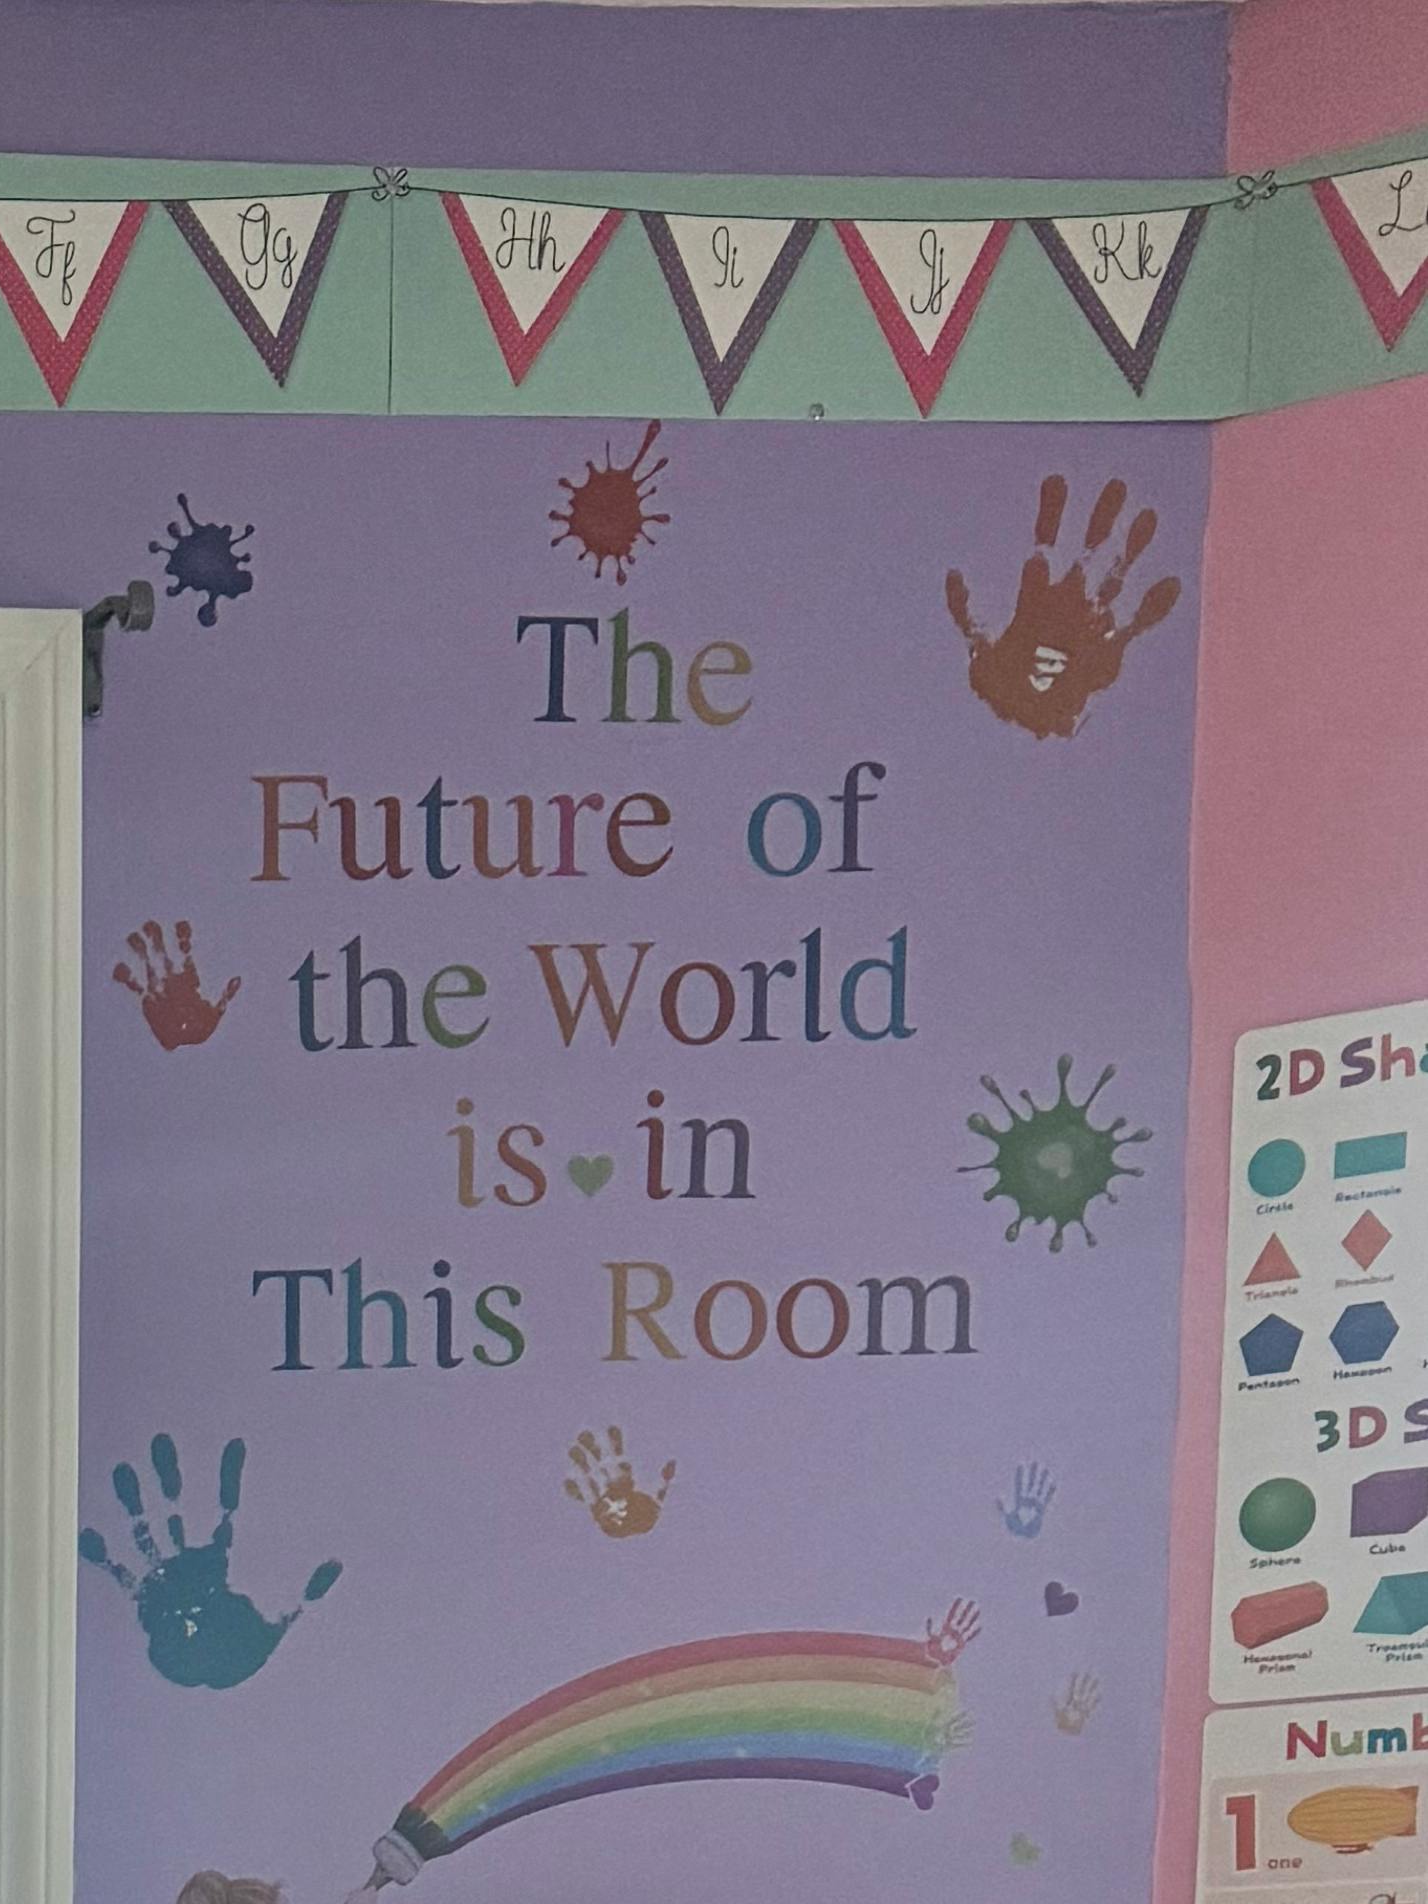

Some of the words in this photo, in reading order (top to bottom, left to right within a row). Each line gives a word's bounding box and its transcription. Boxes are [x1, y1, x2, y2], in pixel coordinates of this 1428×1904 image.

[1378, 170, 1428, 236] L
[27, 210, 79, 306] Ff
[237, 202, 298, 291] Gg
[496, 208, 566, 275] Hh
[708, 227, 744, 289] Ii
[910, 228, 951, 316] Jj
[1092, 222, 1161, 283] Kk
[516, 607, 754, 726] The
[249, 774, 675, 882] Future
[745, 761, 887, 877] of
[290, 934, 490, 1051] the
[528, 925, 918, 1048] World
[1255, 1048, 1325, 1101] 2D
[447, 1097, 549, 1208] is
[637, 1089, 756, 1200] in
[1256, 1202, 1294, 1215] Circle
[251, 1258, 527, 1371] This
[600, 1260, 979, 1362] Room
[1238, 1377, 1300, 1391] Pentagon
[1314, 1405, 1388, 1453] 3D
[1249, 1556, 1301, 1569] Sphere
[1369, 1543, 1406, 1555] Cube
[1226, 1794, 1256, 1871] 1
[1267, 1856, 1303, 1870] one
